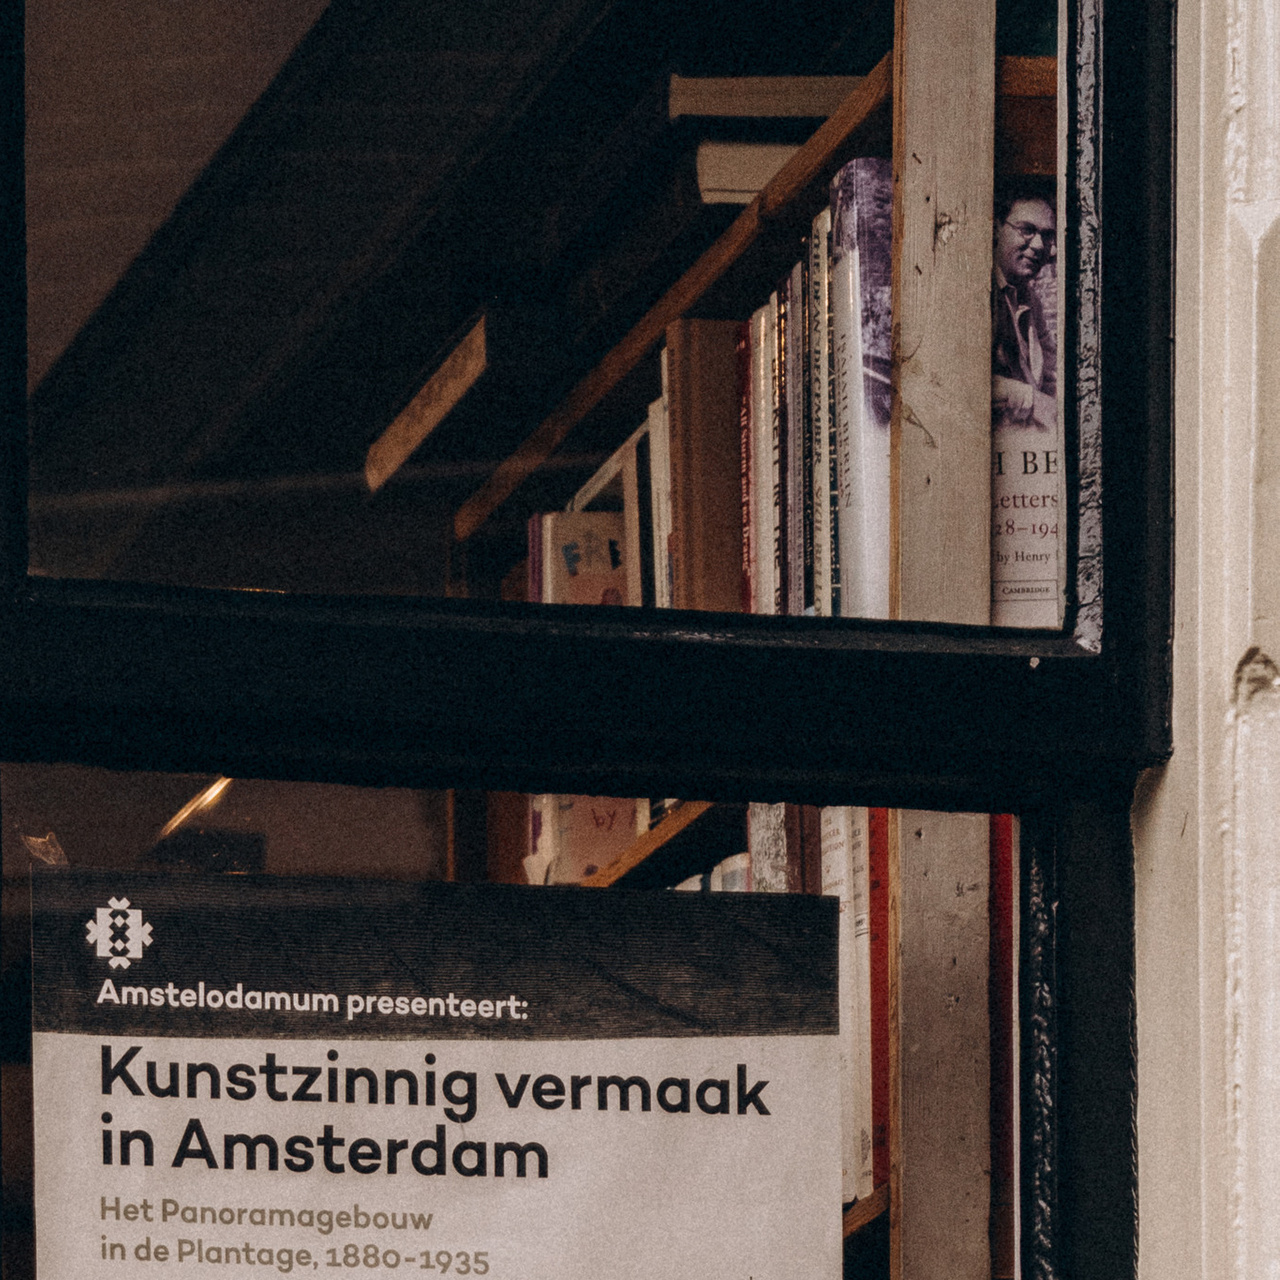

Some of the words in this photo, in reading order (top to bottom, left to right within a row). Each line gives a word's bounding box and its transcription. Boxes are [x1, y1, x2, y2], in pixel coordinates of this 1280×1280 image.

[97, 978, 340, 1013] Amstelodamum
[346, 993, 530, 1021] presenteert:
[101, 1045, 478, 1123] Kunstzinnig
[494, 1063, 771, 1116] vermaak
[101, 1111, 155, 1167] in
[171, 1117, 549, 1180] Amsterdam
[100, 1196, 154, 1223] Het
[160, 1199, 434, 1235] Panoramagebouw
[100, 1236, 126, 1261] in
[133, 1237, 170, 1263] de
[177, 1239, 319, 1272] Plantage,
[325, 1246, 491, 1276] 1880-1935
